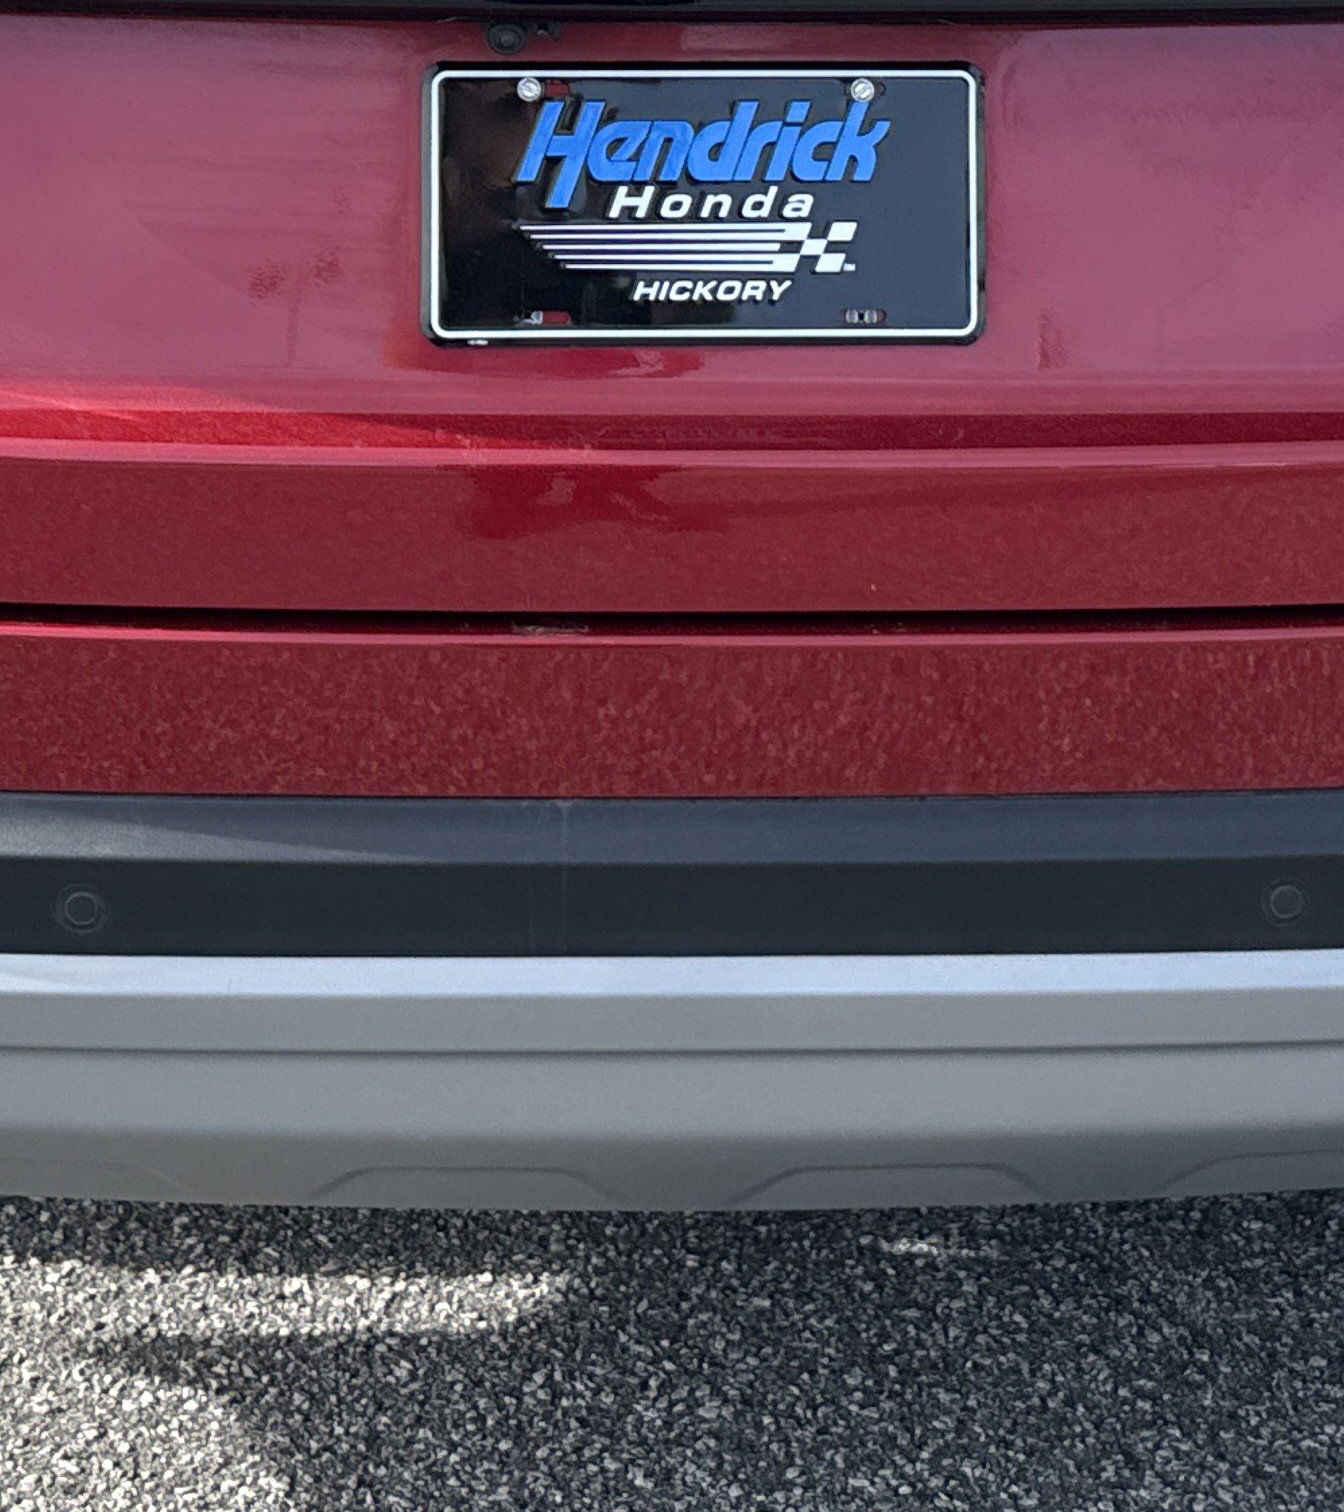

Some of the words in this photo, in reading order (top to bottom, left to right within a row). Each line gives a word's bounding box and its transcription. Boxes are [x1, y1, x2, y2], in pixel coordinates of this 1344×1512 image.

[514, 99, 890, 208] Hendrick
[609, 186, 814, 219] Honda
[633, 279, 792, 302] HICKORY
